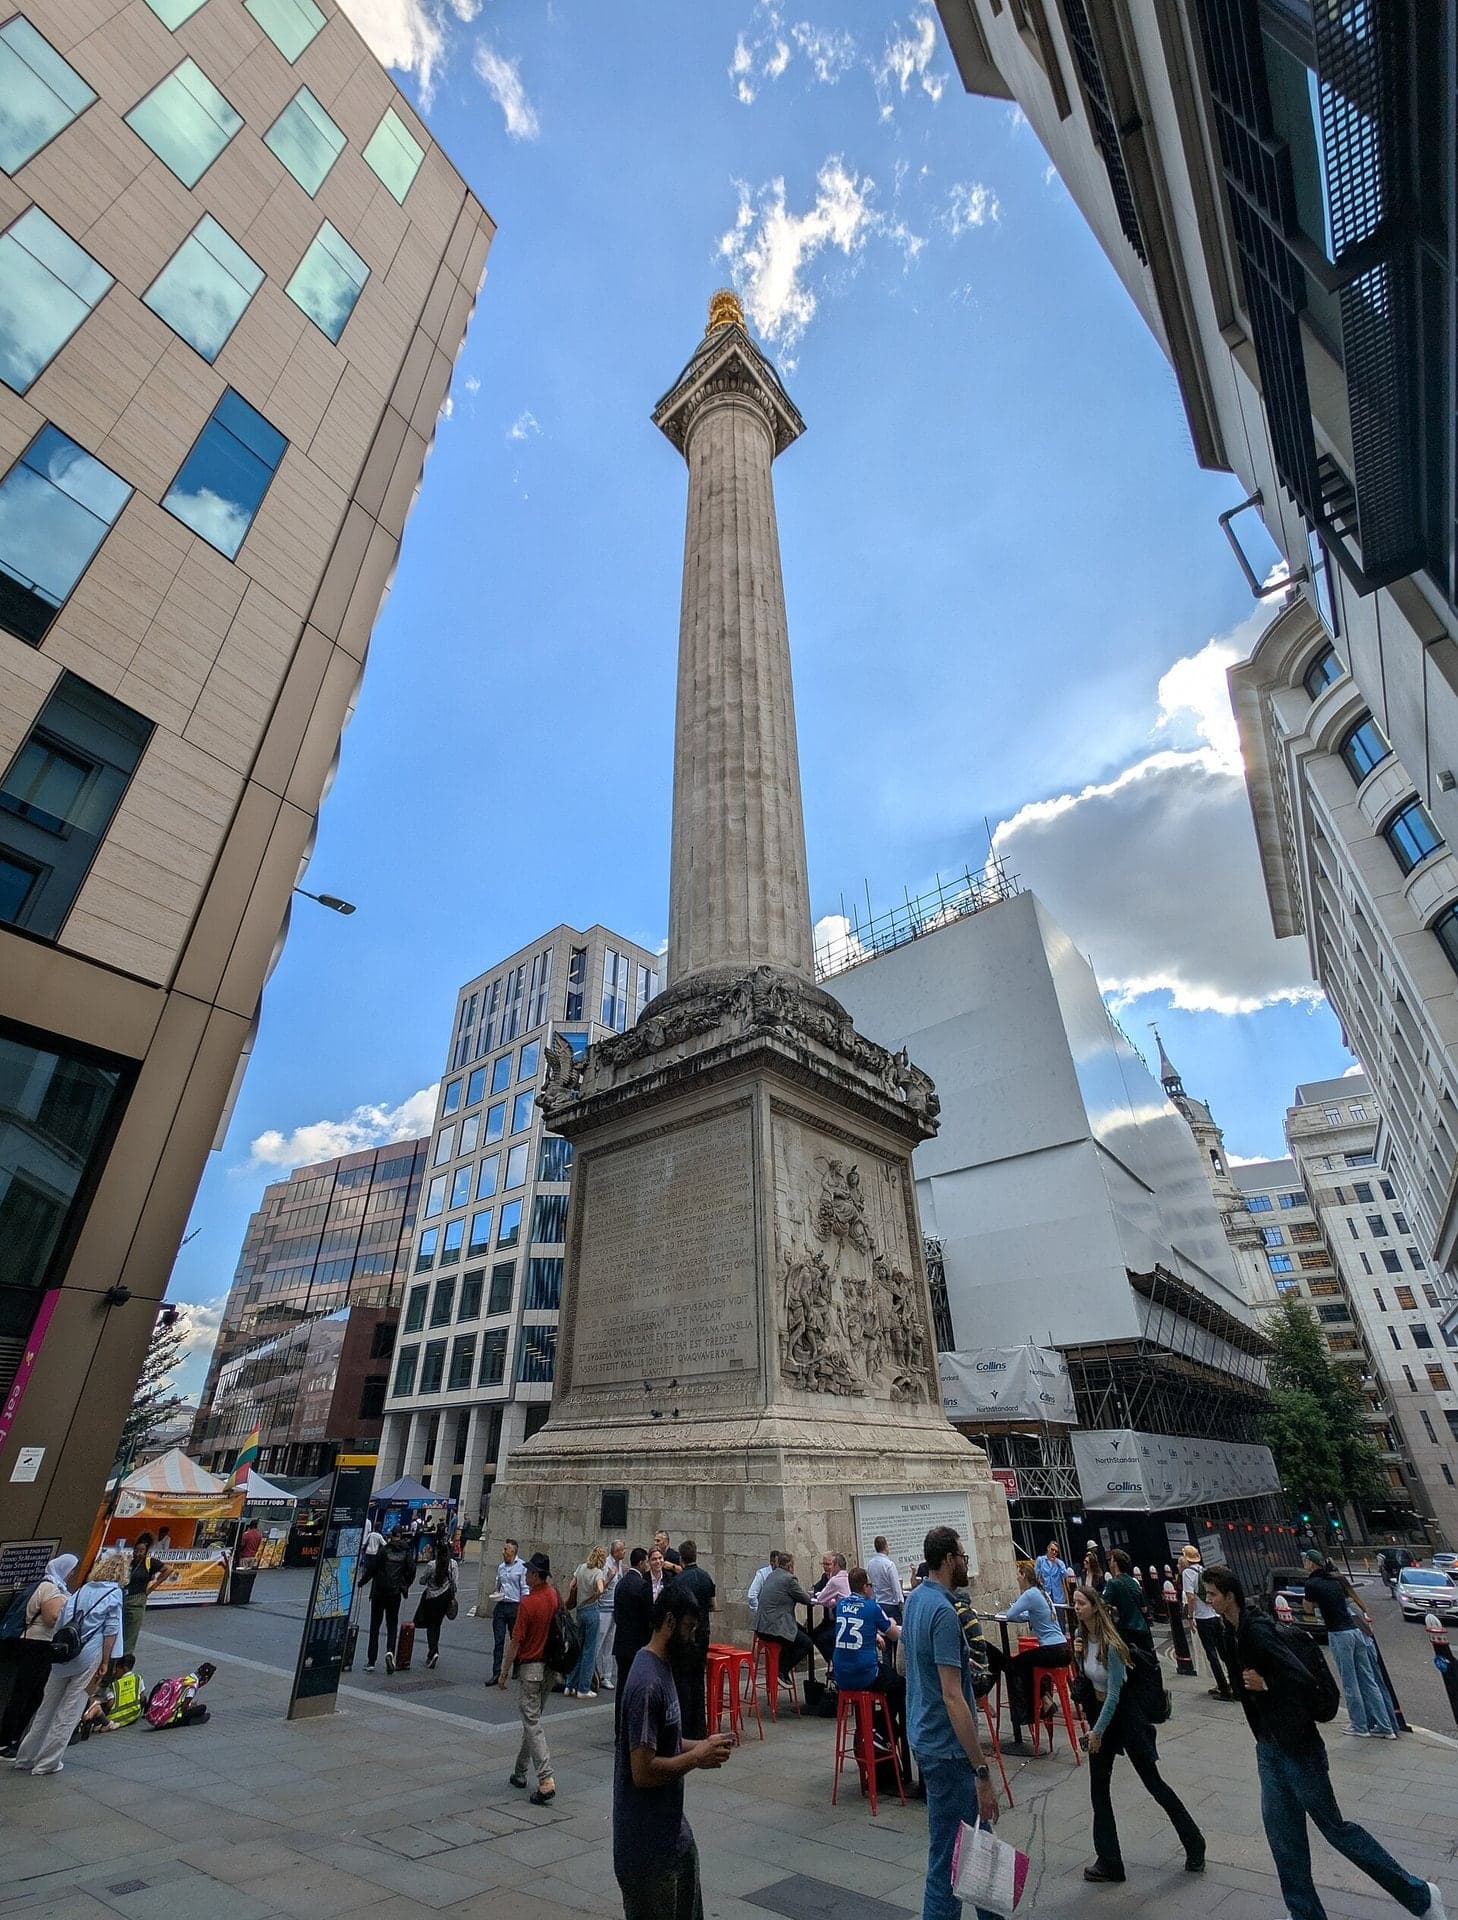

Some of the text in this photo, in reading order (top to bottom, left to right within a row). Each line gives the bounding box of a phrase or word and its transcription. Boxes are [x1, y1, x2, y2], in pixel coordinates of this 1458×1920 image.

[976, 1362, 1006, 1372] Collins
[1106, 1482, 1142, 1491] Collins
[835, 1616, 864, 1650] 23
